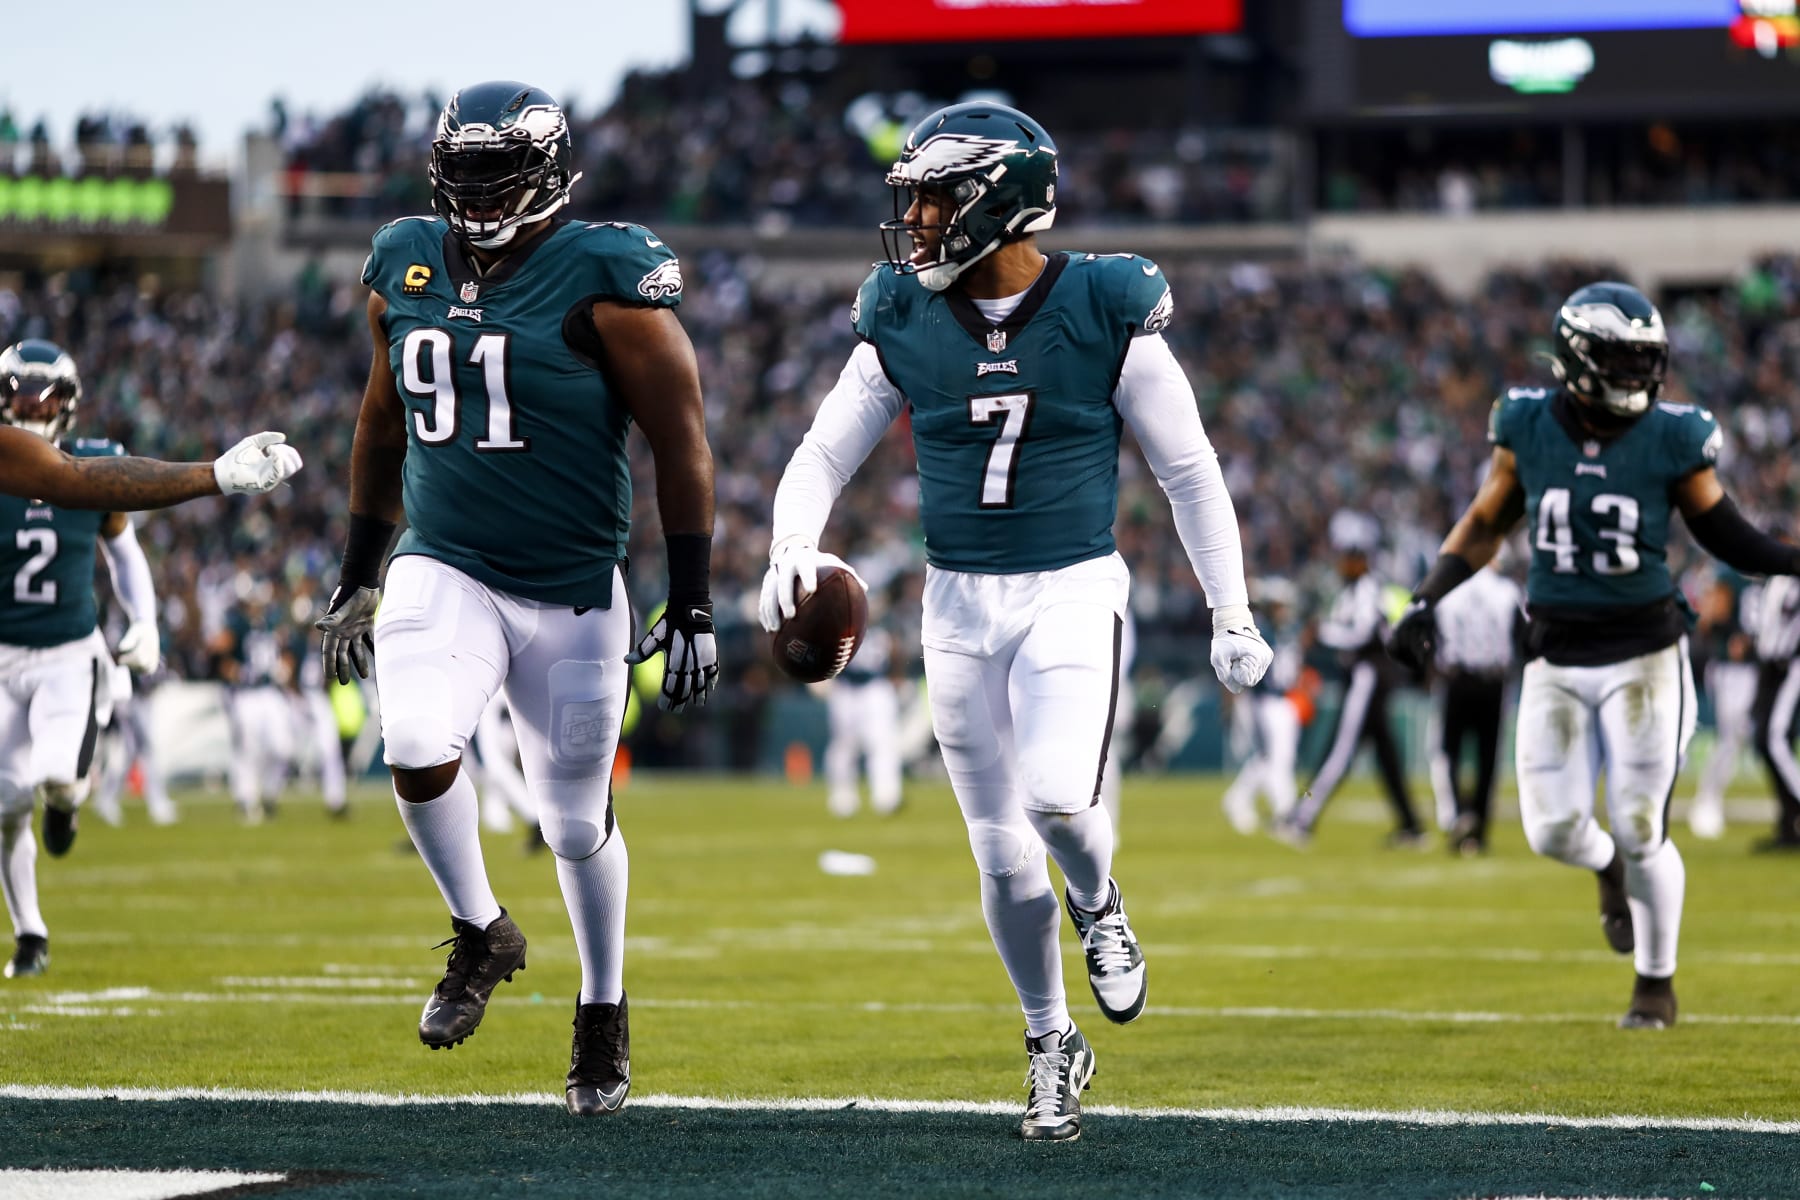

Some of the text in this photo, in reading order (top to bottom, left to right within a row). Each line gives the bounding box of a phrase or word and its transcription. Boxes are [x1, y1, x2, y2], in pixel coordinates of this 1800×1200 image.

[404, 264, 432, 287] C
[447, 306, 484, 322] EAGLES
[402, 328, 525, 449] 91
[977, 360, 1018, 376] EAGLES
[971, 394, 1029, 504] 7
[13, 527, 57, 604] 2
[1536, 487, 1641, 574] 43
